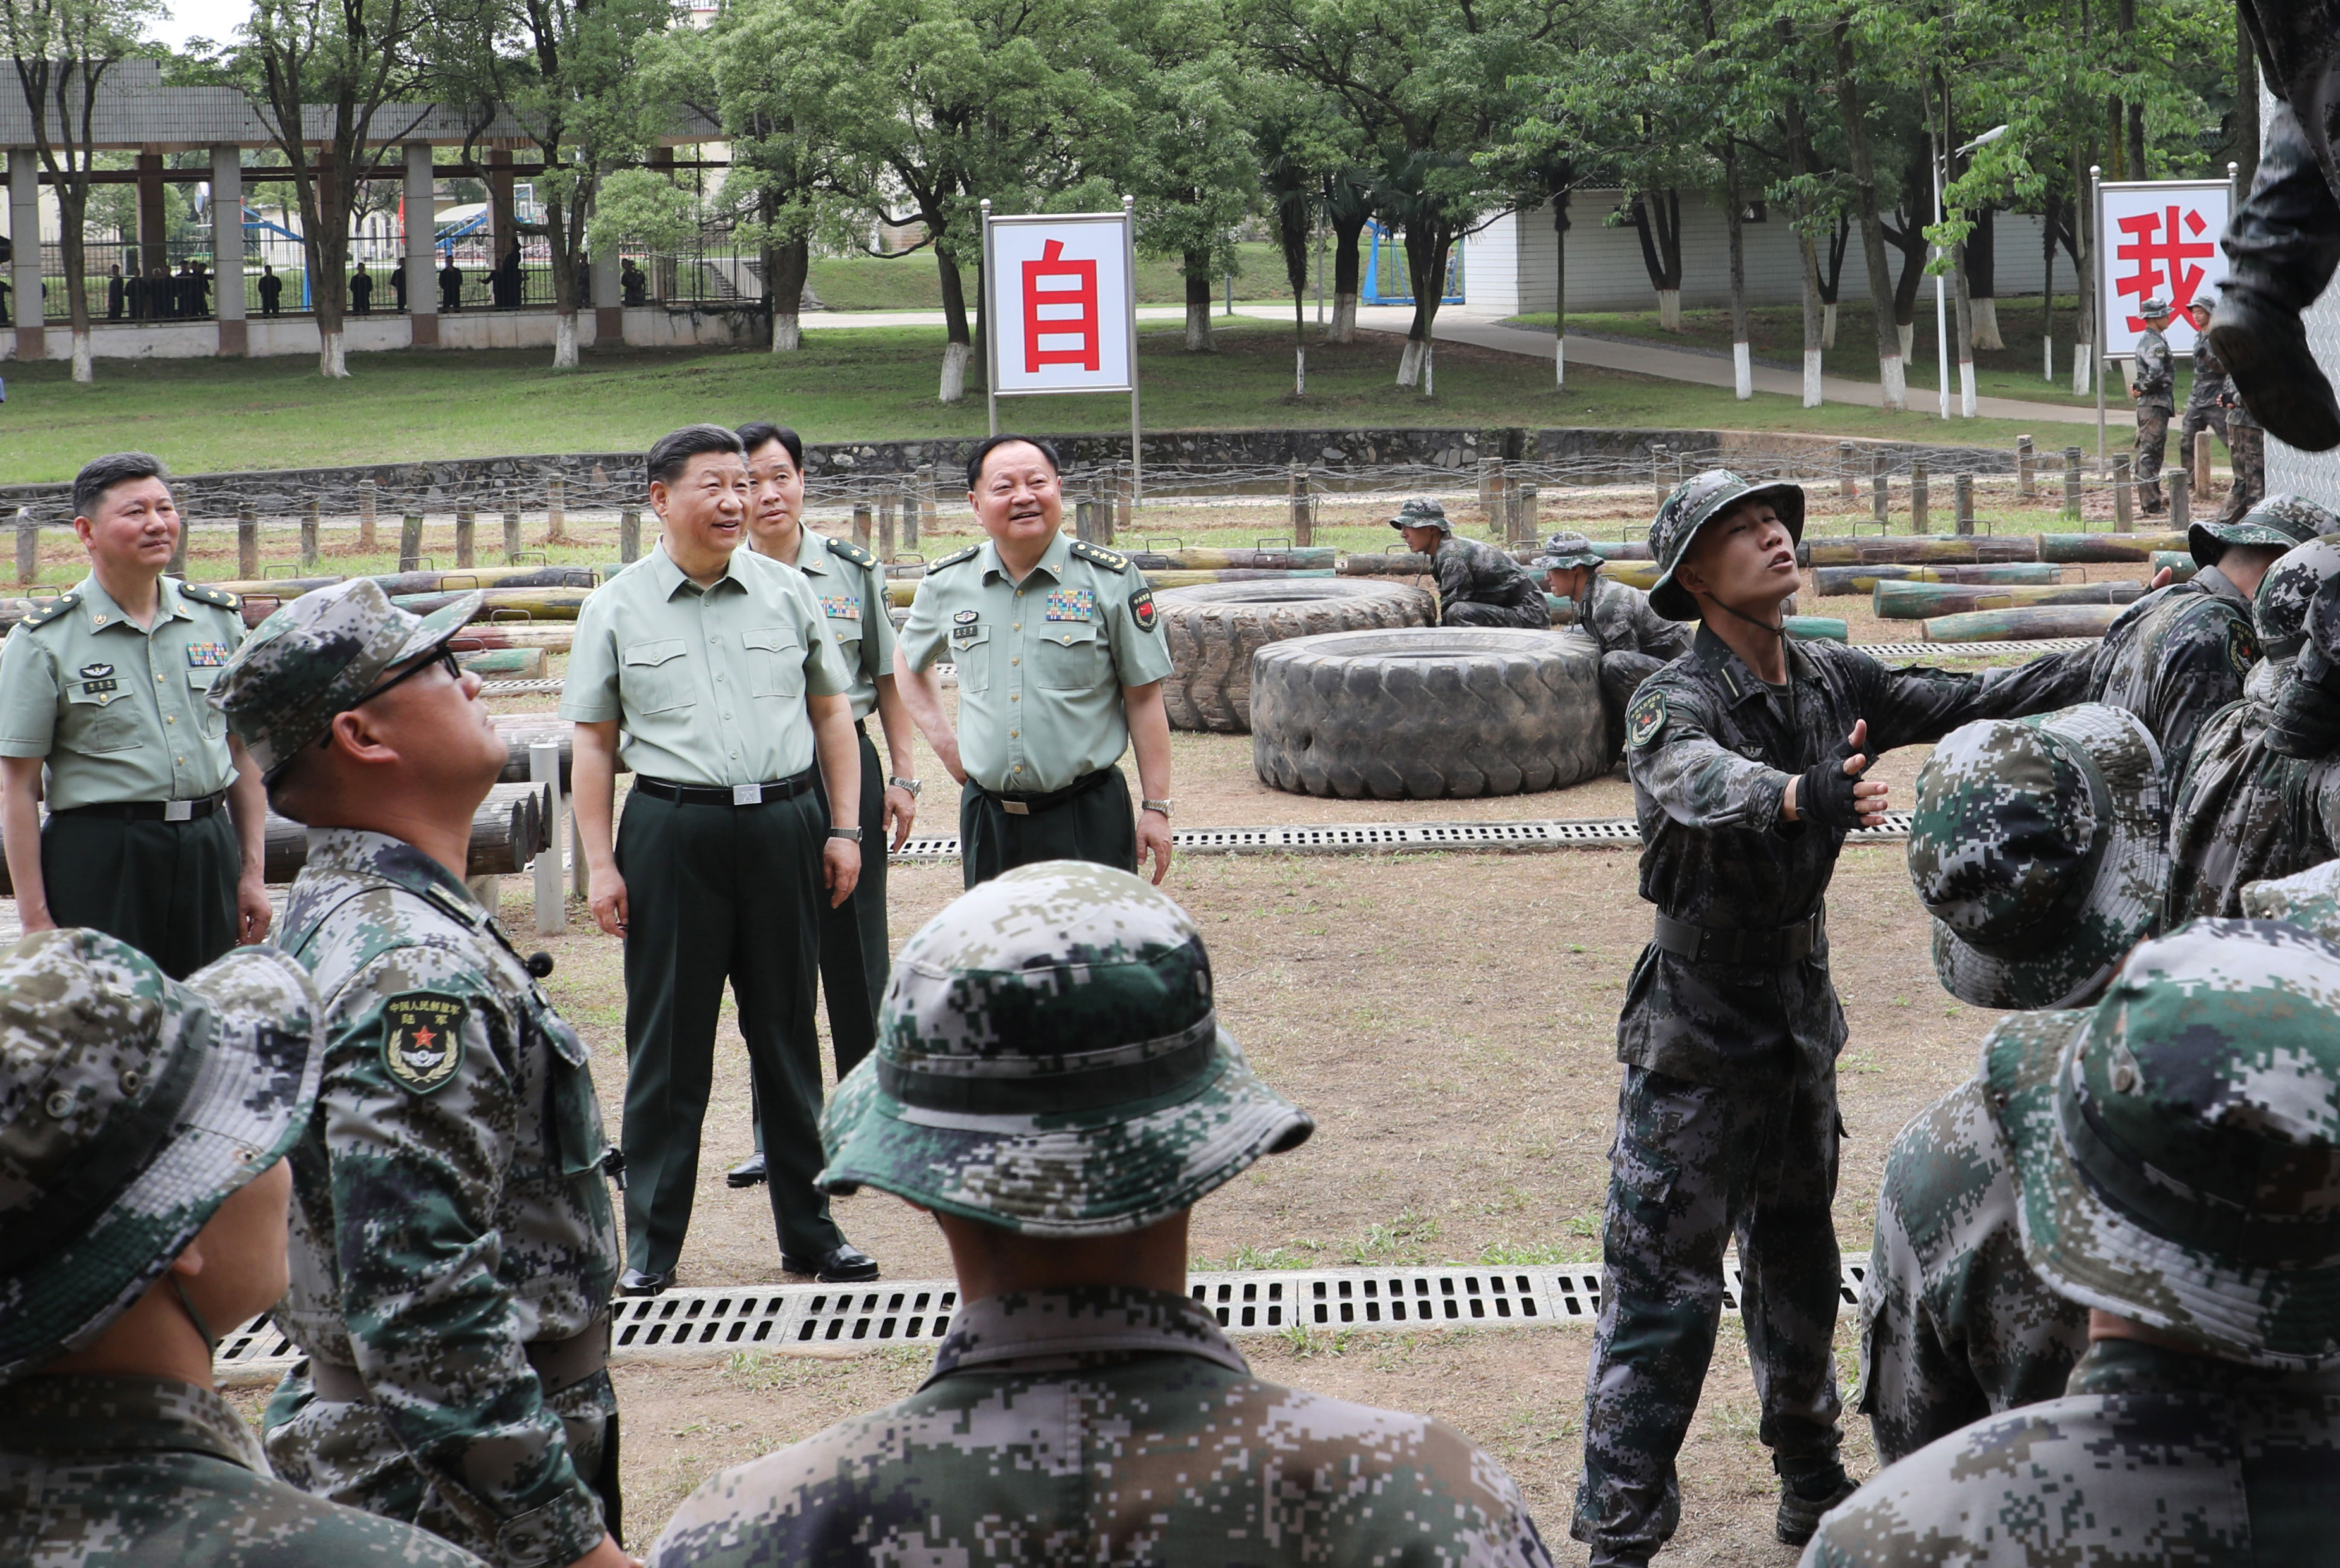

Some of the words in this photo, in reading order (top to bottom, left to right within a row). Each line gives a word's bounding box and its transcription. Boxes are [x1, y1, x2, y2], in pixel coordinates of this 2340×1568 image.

[1021, 239, 1100, 373] 自
[2116, 205, 2214, 333] 我
[389, 1000, 461, 1016] 中国人民解放军
